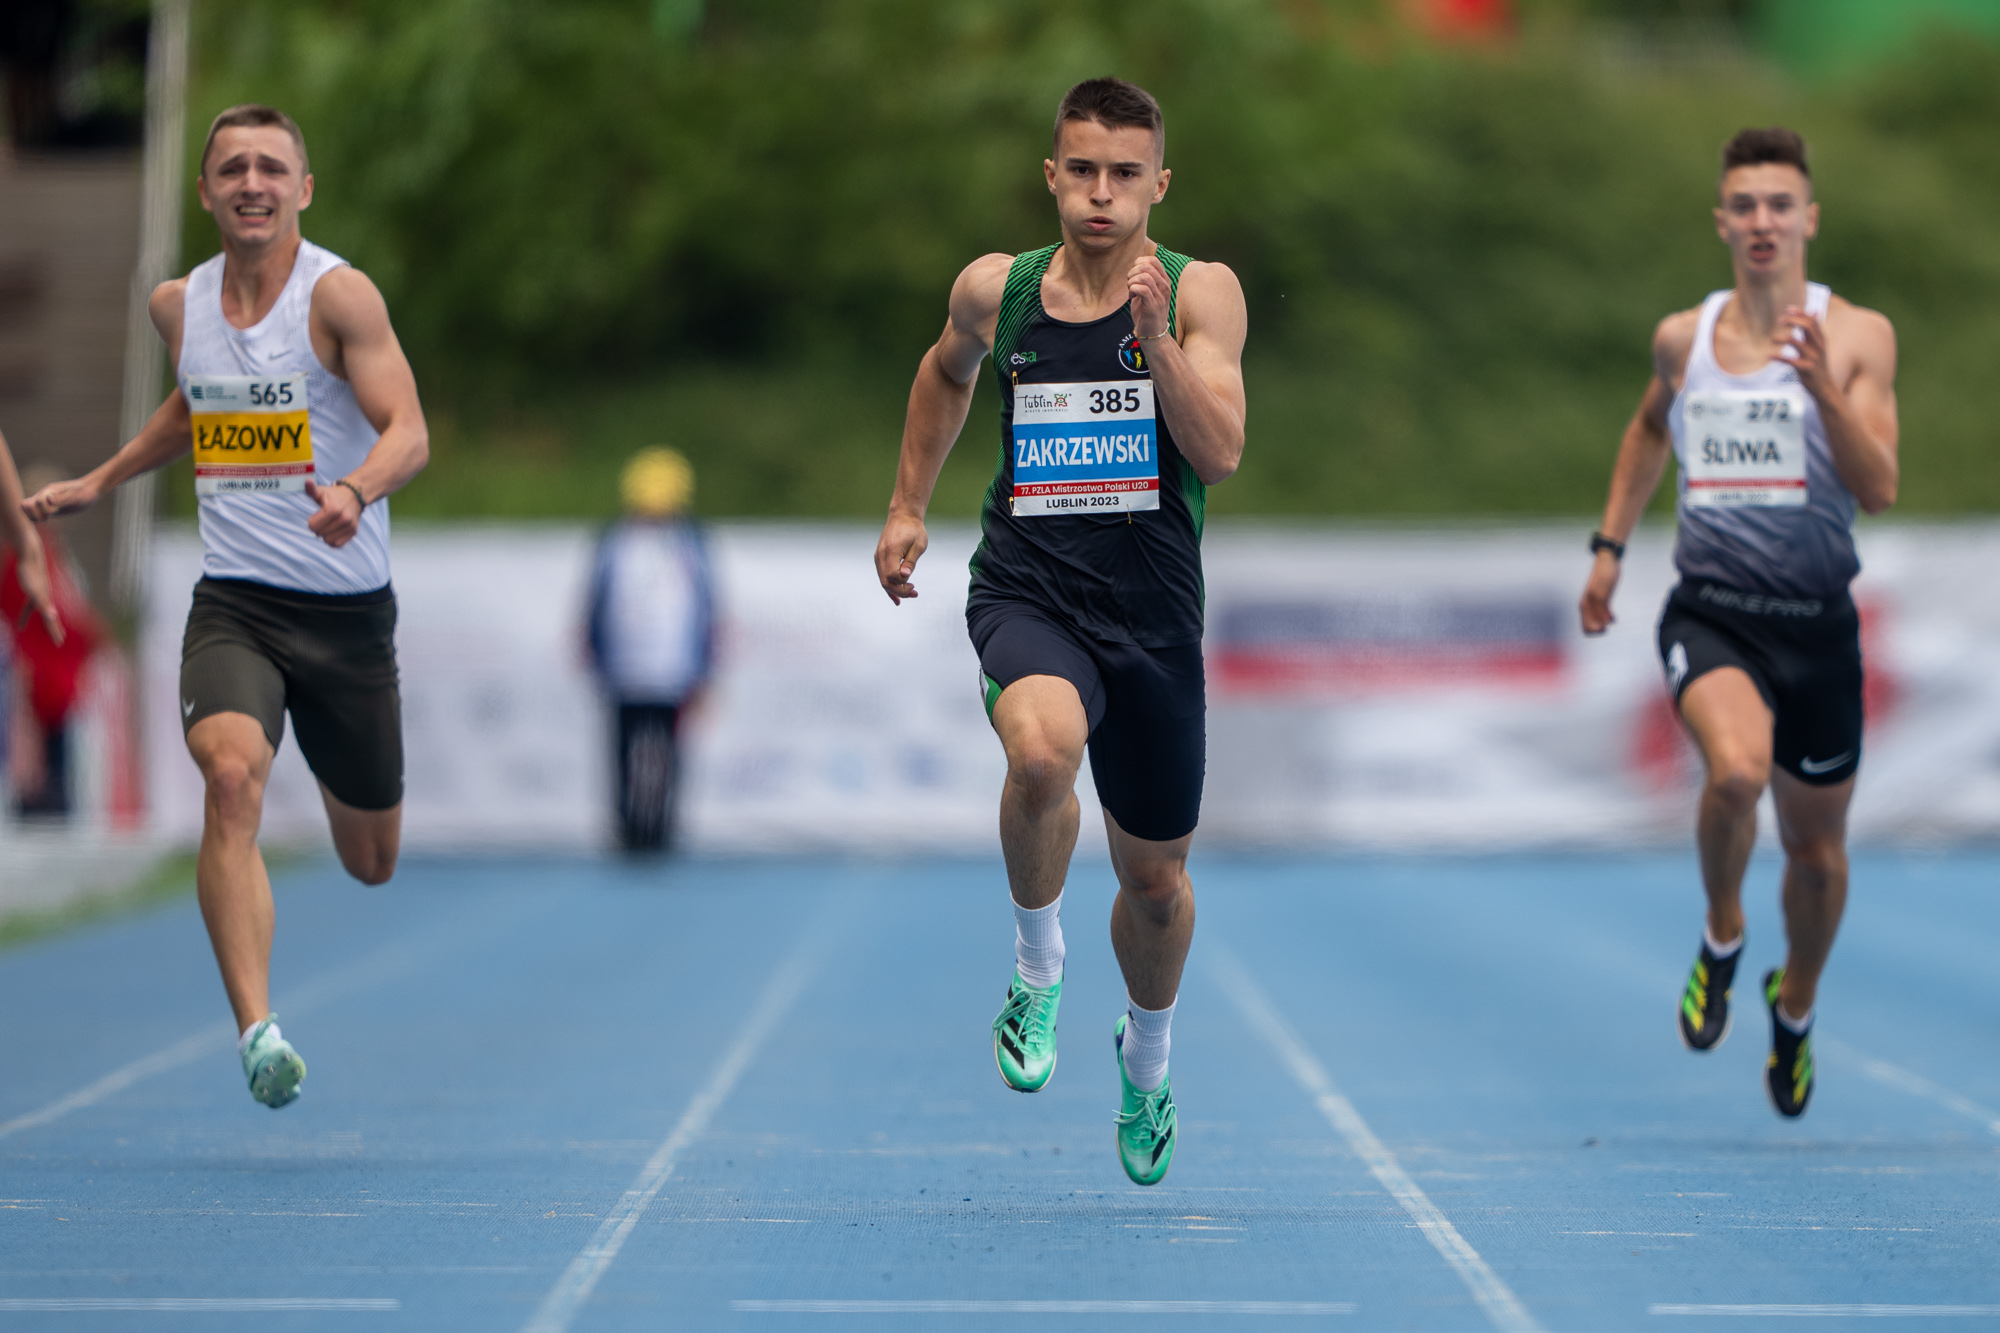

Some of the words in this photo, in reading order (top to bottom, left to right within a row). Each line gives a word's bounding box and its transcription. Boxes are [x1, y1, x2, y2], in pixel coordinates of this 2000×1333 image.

[250, 382, 293, 405] 565
[1089, 388, 1140, 414] 385
[1747, 400, 1790, 424] 272
[199, 423, 305, 450] ŁAZOWY
[1702, 434, 1783, 464] ŚLIWA
[1016, 434, 1150, 468] ZAKRZEWSKI
[1021, 487, 1031, 495] 77.
[1032, 486, 1051, 494] PZLA
[1052, 484, 1103, 493] Mistrzostwa
[1105, 482, 1130, 491] Polski
[1132, 481, 1149, 490] U20
[1046, 498, 1088, 508] LUBLIN
[1090, 496, 1119, 506] 2023
